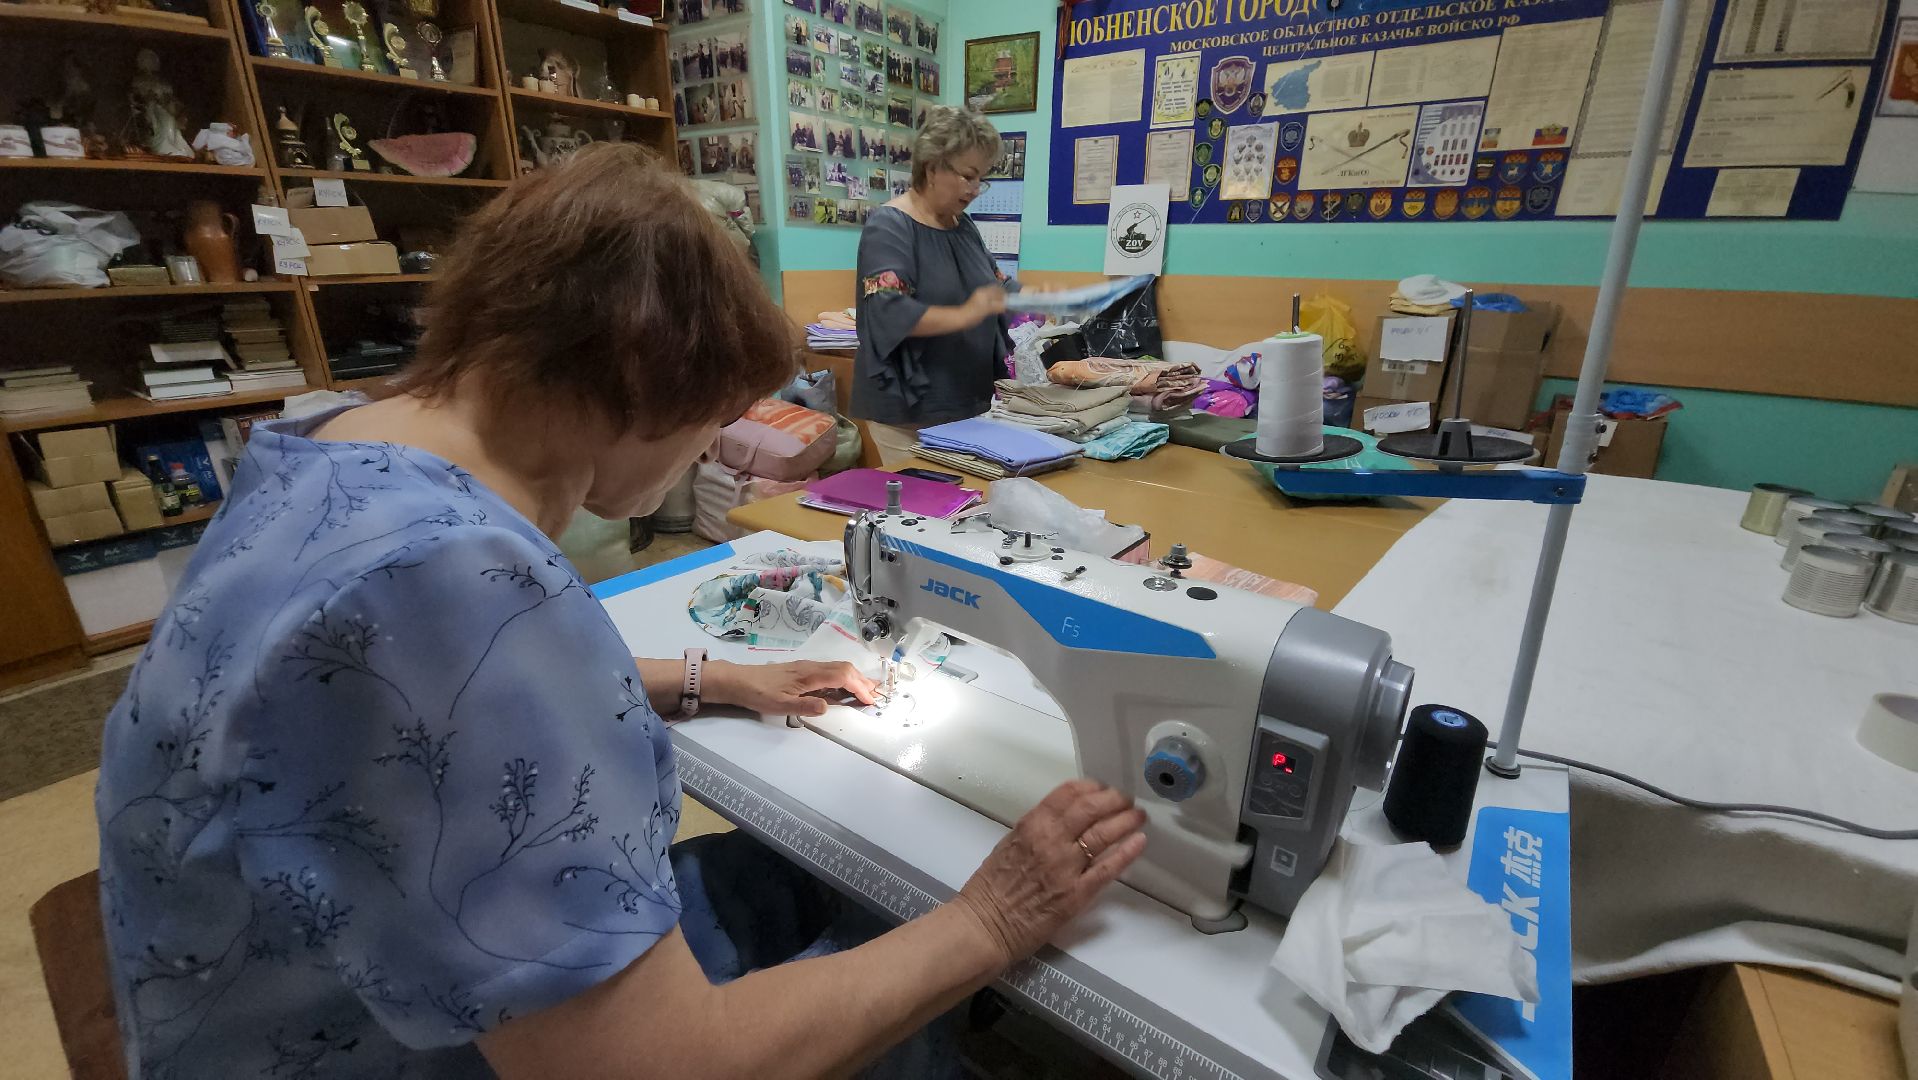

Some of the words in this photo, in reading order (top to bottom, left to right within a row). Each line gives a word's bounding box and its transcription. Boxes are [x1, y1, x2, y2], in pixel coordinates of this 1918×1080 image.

[1169, 29, 1269, 53] МОСКОВСКОЕ
[1272, 14, 1370, 43] ОБЛАСТНОЕ
[1375, 0, 1497, 27] ОТДЕЛЬСКОЕ
[1262, 34, 1358, 57] ЦЕНТРАЛЬНОЕ
[1361, 26, 1424, 44] КАЗАЧЬЕ
[1428, 17, 1493, 35] ВОЙСКО
[1497, 14, 1521, 27] РФ
[1125, 239, 1144, 247] ZOV
[1174, 1056, 1184, 1067] 35
